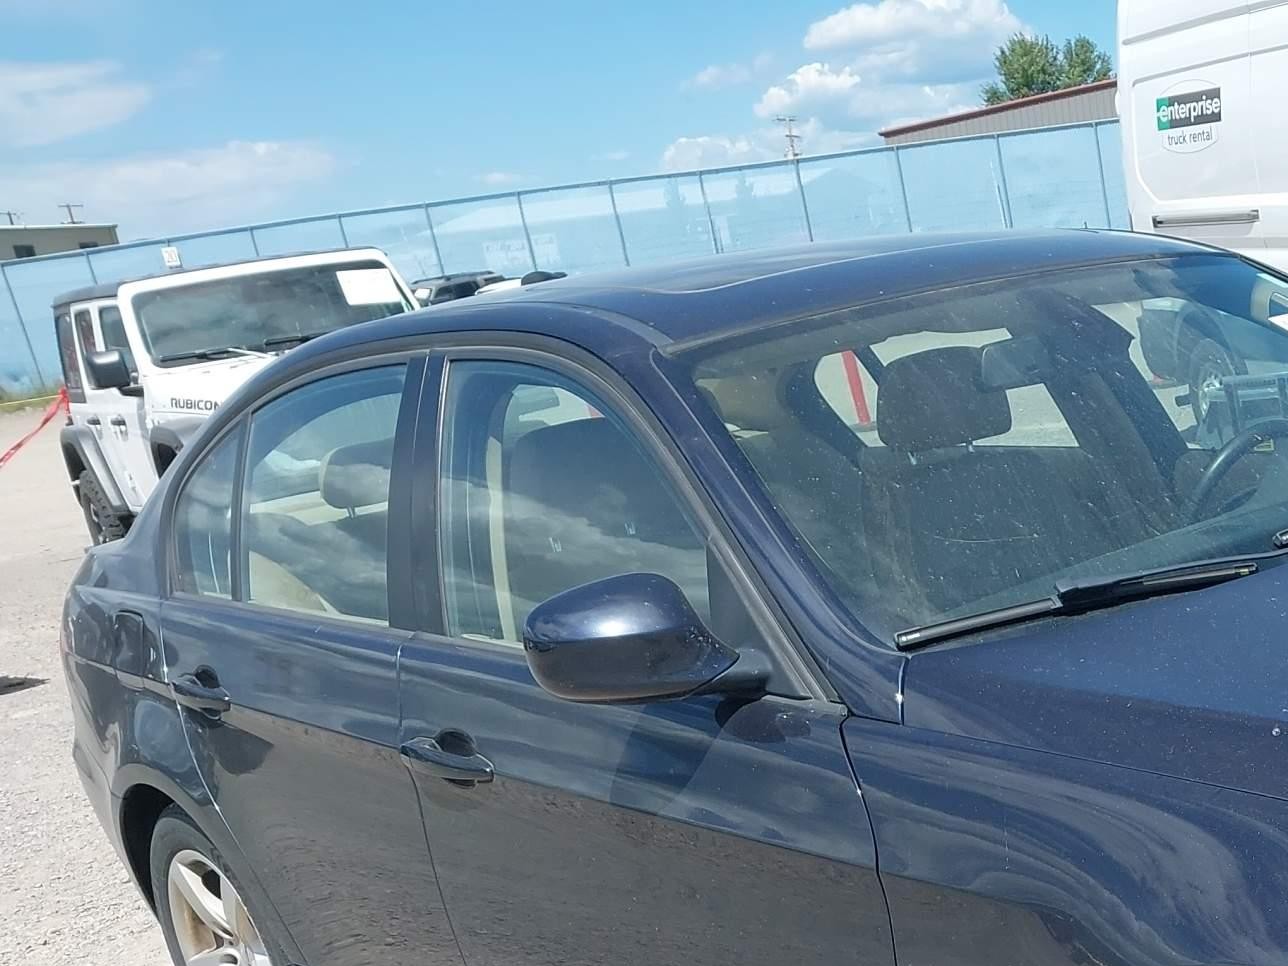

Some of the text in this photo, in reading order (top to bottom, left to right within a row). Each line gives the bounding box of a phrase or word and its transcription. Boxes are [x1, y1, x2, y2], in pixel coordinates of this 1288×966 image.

[1158, 94, 1221, 123] enterprise
[1167, 125, 1213, 146] truck rental
